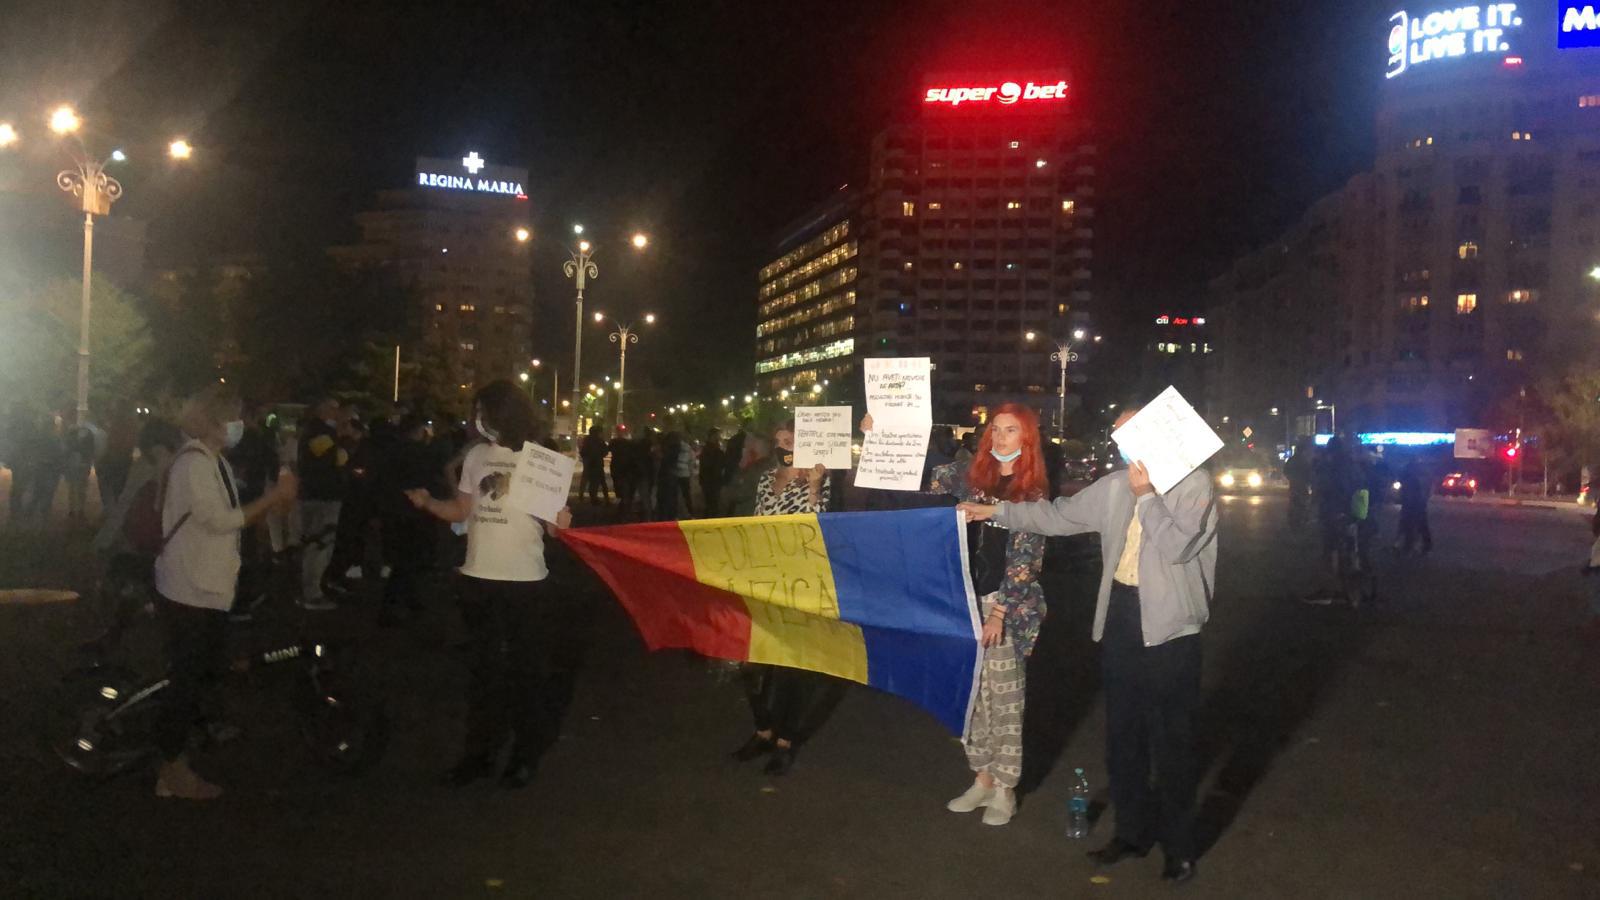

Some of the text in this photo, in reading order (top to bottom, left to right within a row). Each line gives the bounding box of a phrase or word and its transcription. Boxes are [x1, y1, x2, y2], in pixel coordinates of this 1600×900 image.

[1411, 3, 1523, 40] LOVE IT.
[1562, 5, 1600, 33] M
[1410, 28, 1510, 64] LIVE IT.
[925, 80, 1069, 106] super bet
[419, 172, 524, 195] REGINA MARIA
[868, 373, 879, 383] NU
[264, 645, 299, 663] MINI
